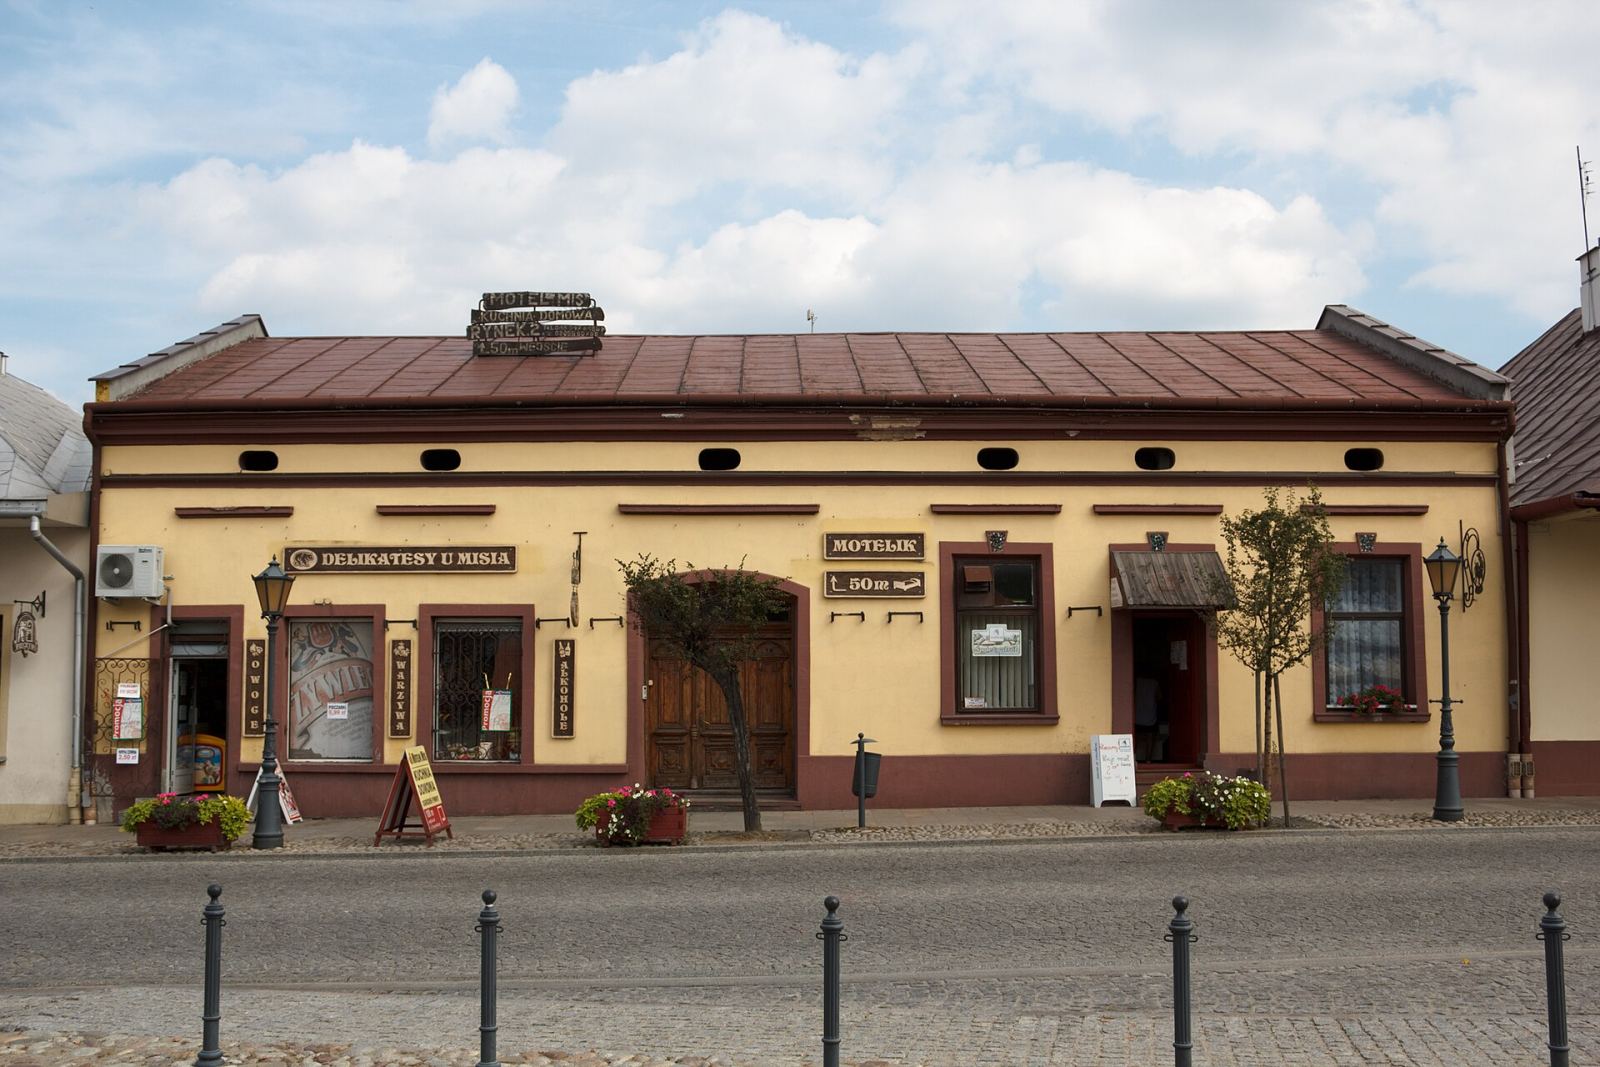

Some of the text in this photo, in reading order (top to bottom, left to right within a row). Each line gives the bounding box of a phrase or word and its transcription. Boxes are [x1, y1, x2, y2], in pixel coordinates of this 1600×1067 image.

[322, 552, 510, 566] DELIKATESY U MISIA
[832, 539, 917, 552] MOTELIK
[395, 661, 407, 730] WARZYWA
[482, 691, 493, 730] Promocja
[560, 661, 569, 731] ALKOHOLE
[113, 700, 123, 738] Promocja
